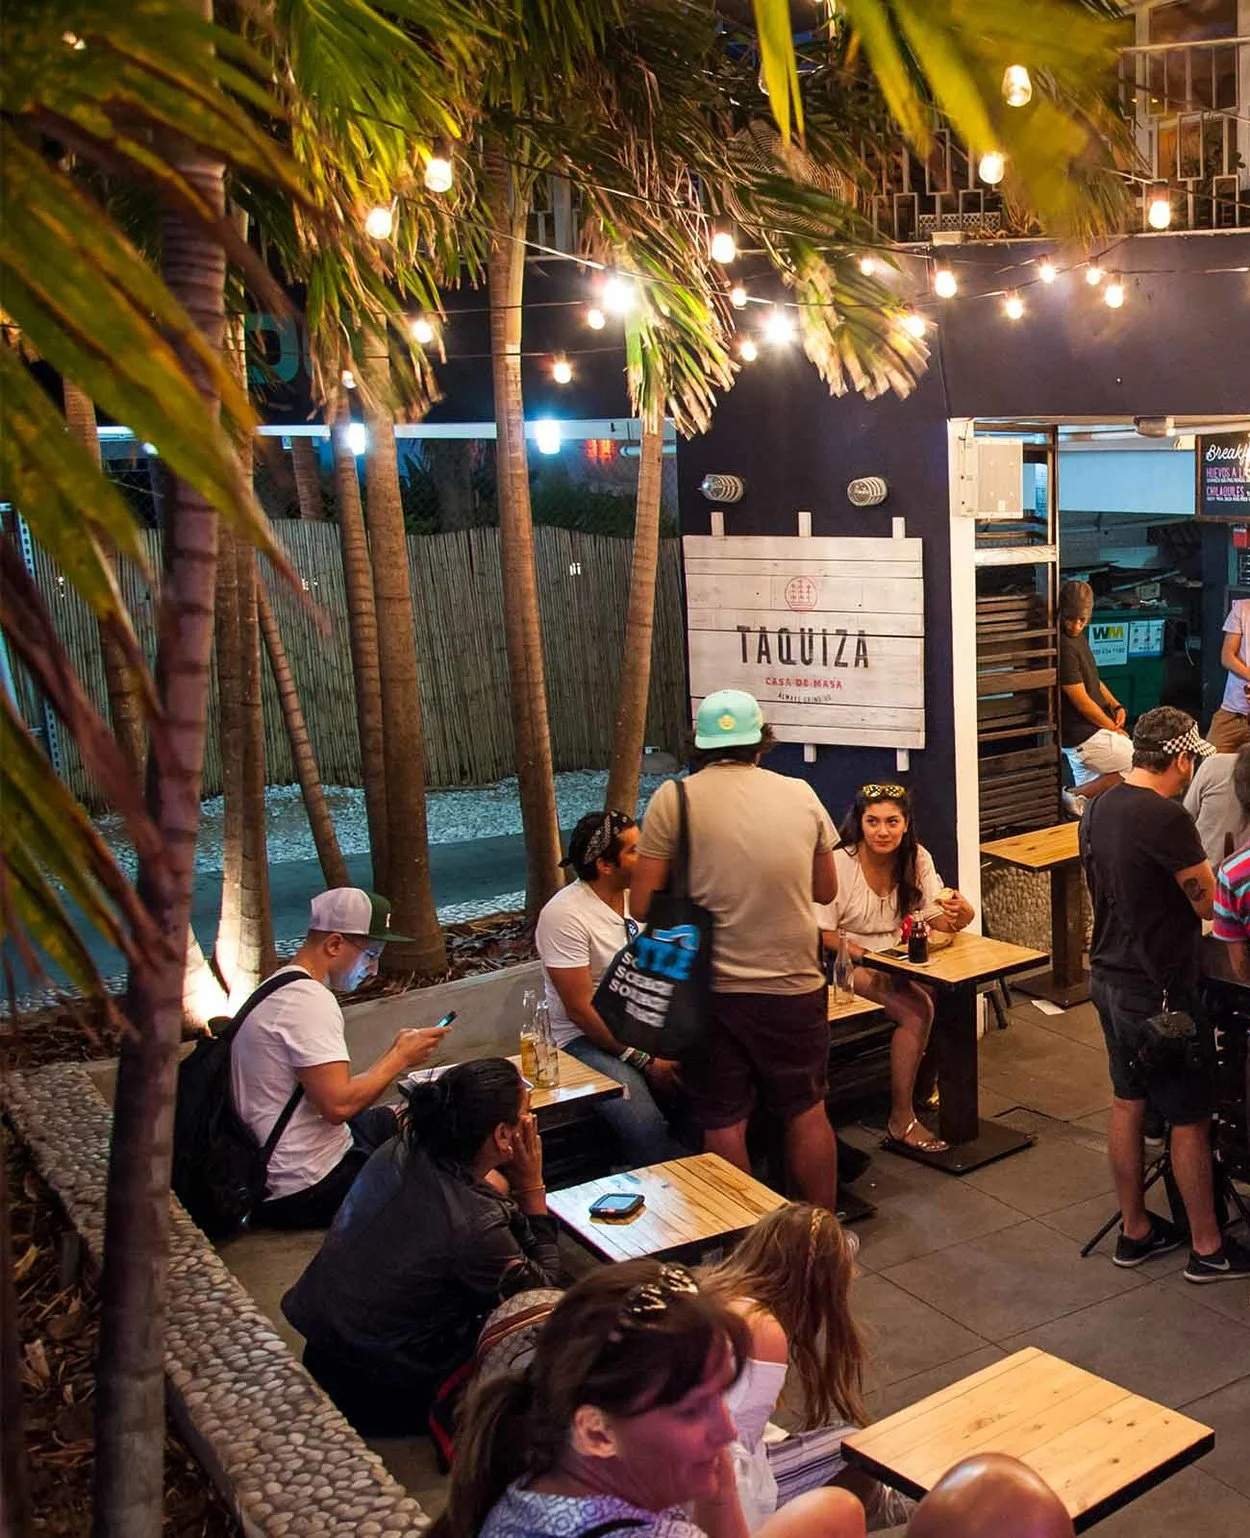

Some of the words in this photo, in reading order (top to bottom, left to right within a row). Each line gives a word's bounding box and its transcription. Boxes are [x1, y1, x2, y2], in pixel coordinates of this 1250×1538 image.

[1092, 625, 1124, 640] WM
[736, 625, 870, 669] TAQUIZA
[765, 677, 791, 687] CASA
[813, 679, 843, 689] MASA
